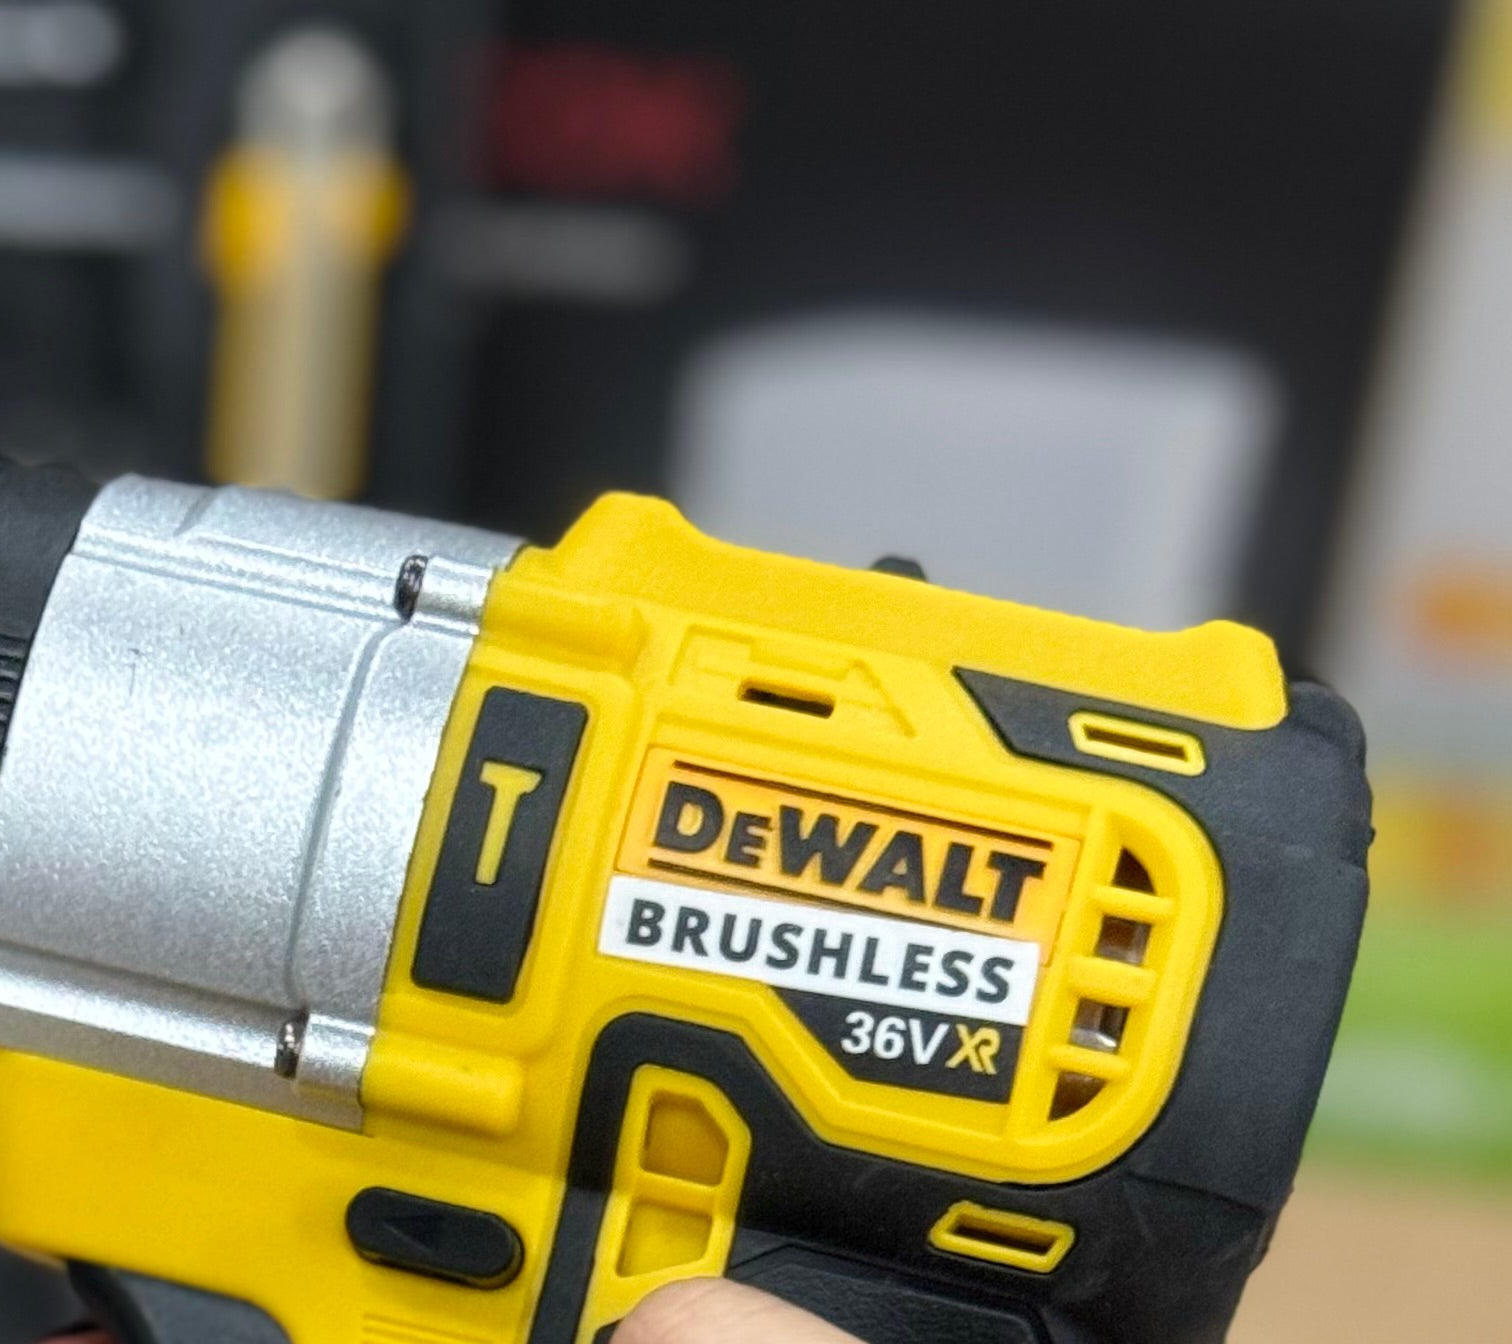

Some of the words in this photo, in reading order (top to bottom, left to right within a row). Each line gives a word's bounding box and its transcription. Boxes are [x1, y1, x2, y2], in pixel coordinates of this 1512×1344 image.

[625, 898, 1016, 1004] BRUSHLESS
[841, 1011, 950, 1066] 36V
[945, 1023, 1001, 1075] XR
